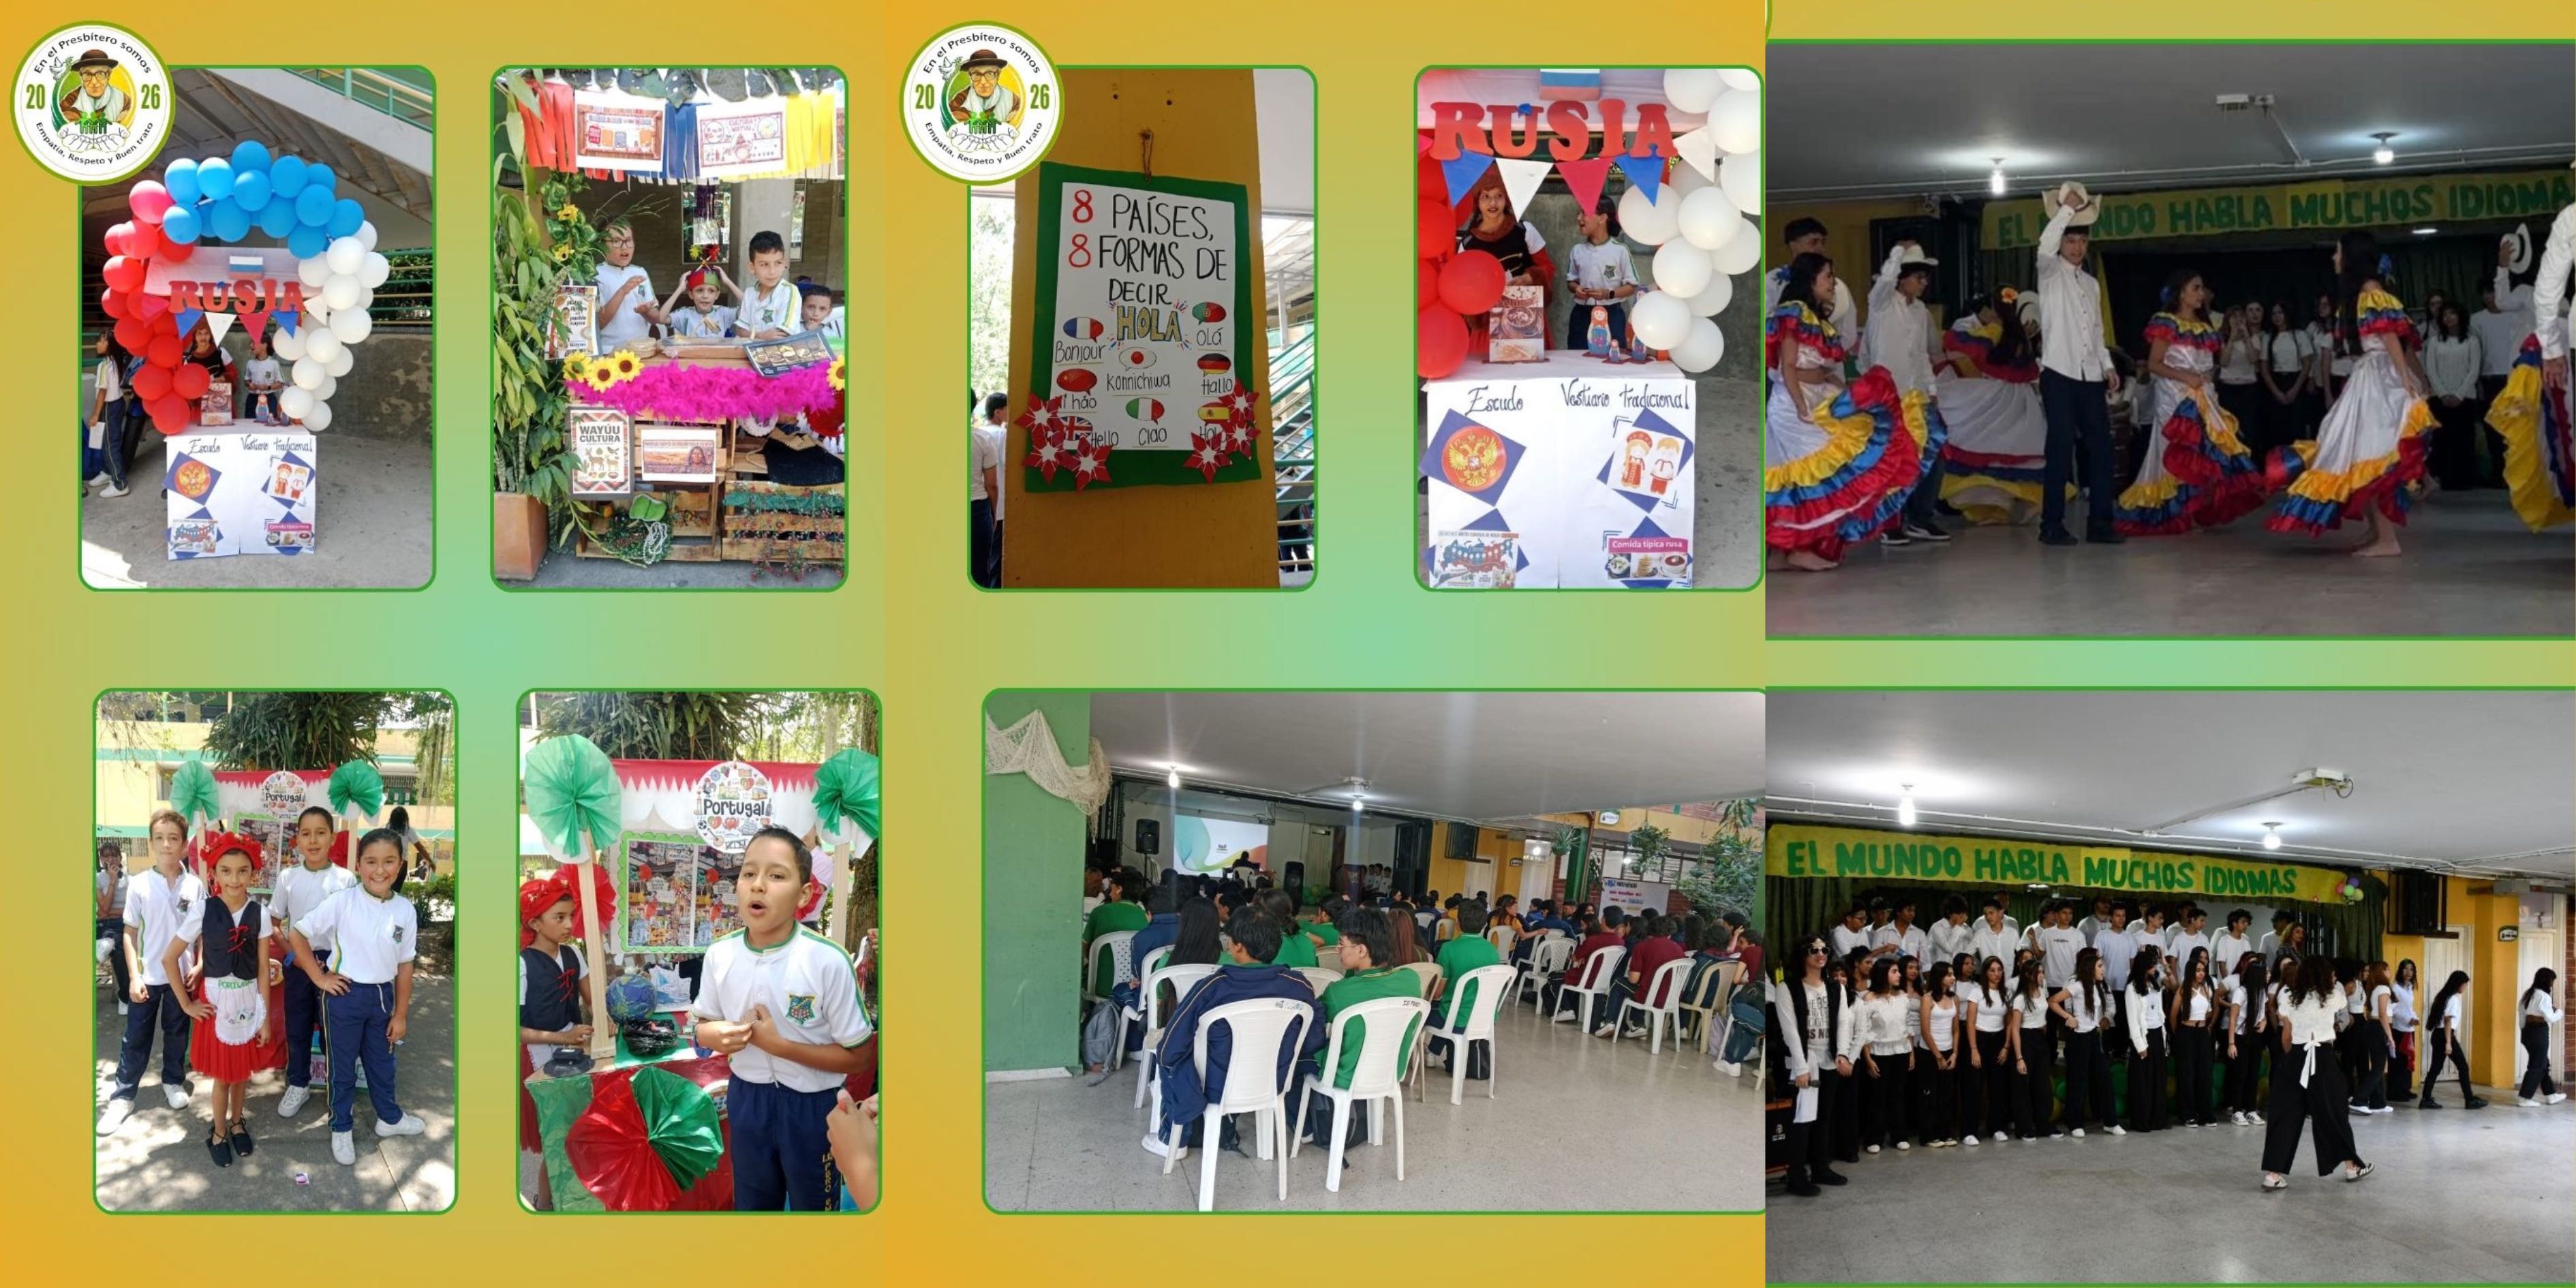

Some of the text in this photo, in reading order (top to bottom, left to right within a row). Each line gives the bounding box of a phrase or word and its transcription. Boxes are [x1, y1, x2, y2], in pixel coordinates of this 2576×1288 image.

[1430, 98, 1678, 162] RUSIA
[1073, 189, 1213, 241] 8 PAÍSES,
[1997, 213, 2031, 247] EL
[2038, 203, 2157, 238] NDO
[2169, 194, 2273, 233] HABLA
[2290, 184, 2435, 228] MUCHOS
[1069, 233, 1227, 281] 8 FORMAS DE
[168, 279, 307, 315] RUSIA
[1109, 278, 1172, 305] DECIR
[1116, 305, 1182, 342] HOLA
[1055, 341, 1106, 363] Bonjour
[1201, 378, 1233, 395] Hallo
[1465, 385, 1524, 415] Escudo
[1561, 378, 1610, 406] Vestuario
[579, 423, 620, 435] WAYÚU
[1090, 430, 1119, 448] Hello
[1612, 540, 1641, 549] Comida
[265, 793, 302, 803] Portugal
[703, 799, 765, 818] Portugal
[1787, 840, 2298, 895] EL MUNDO HABLA MUCHOS IDIOMAS
